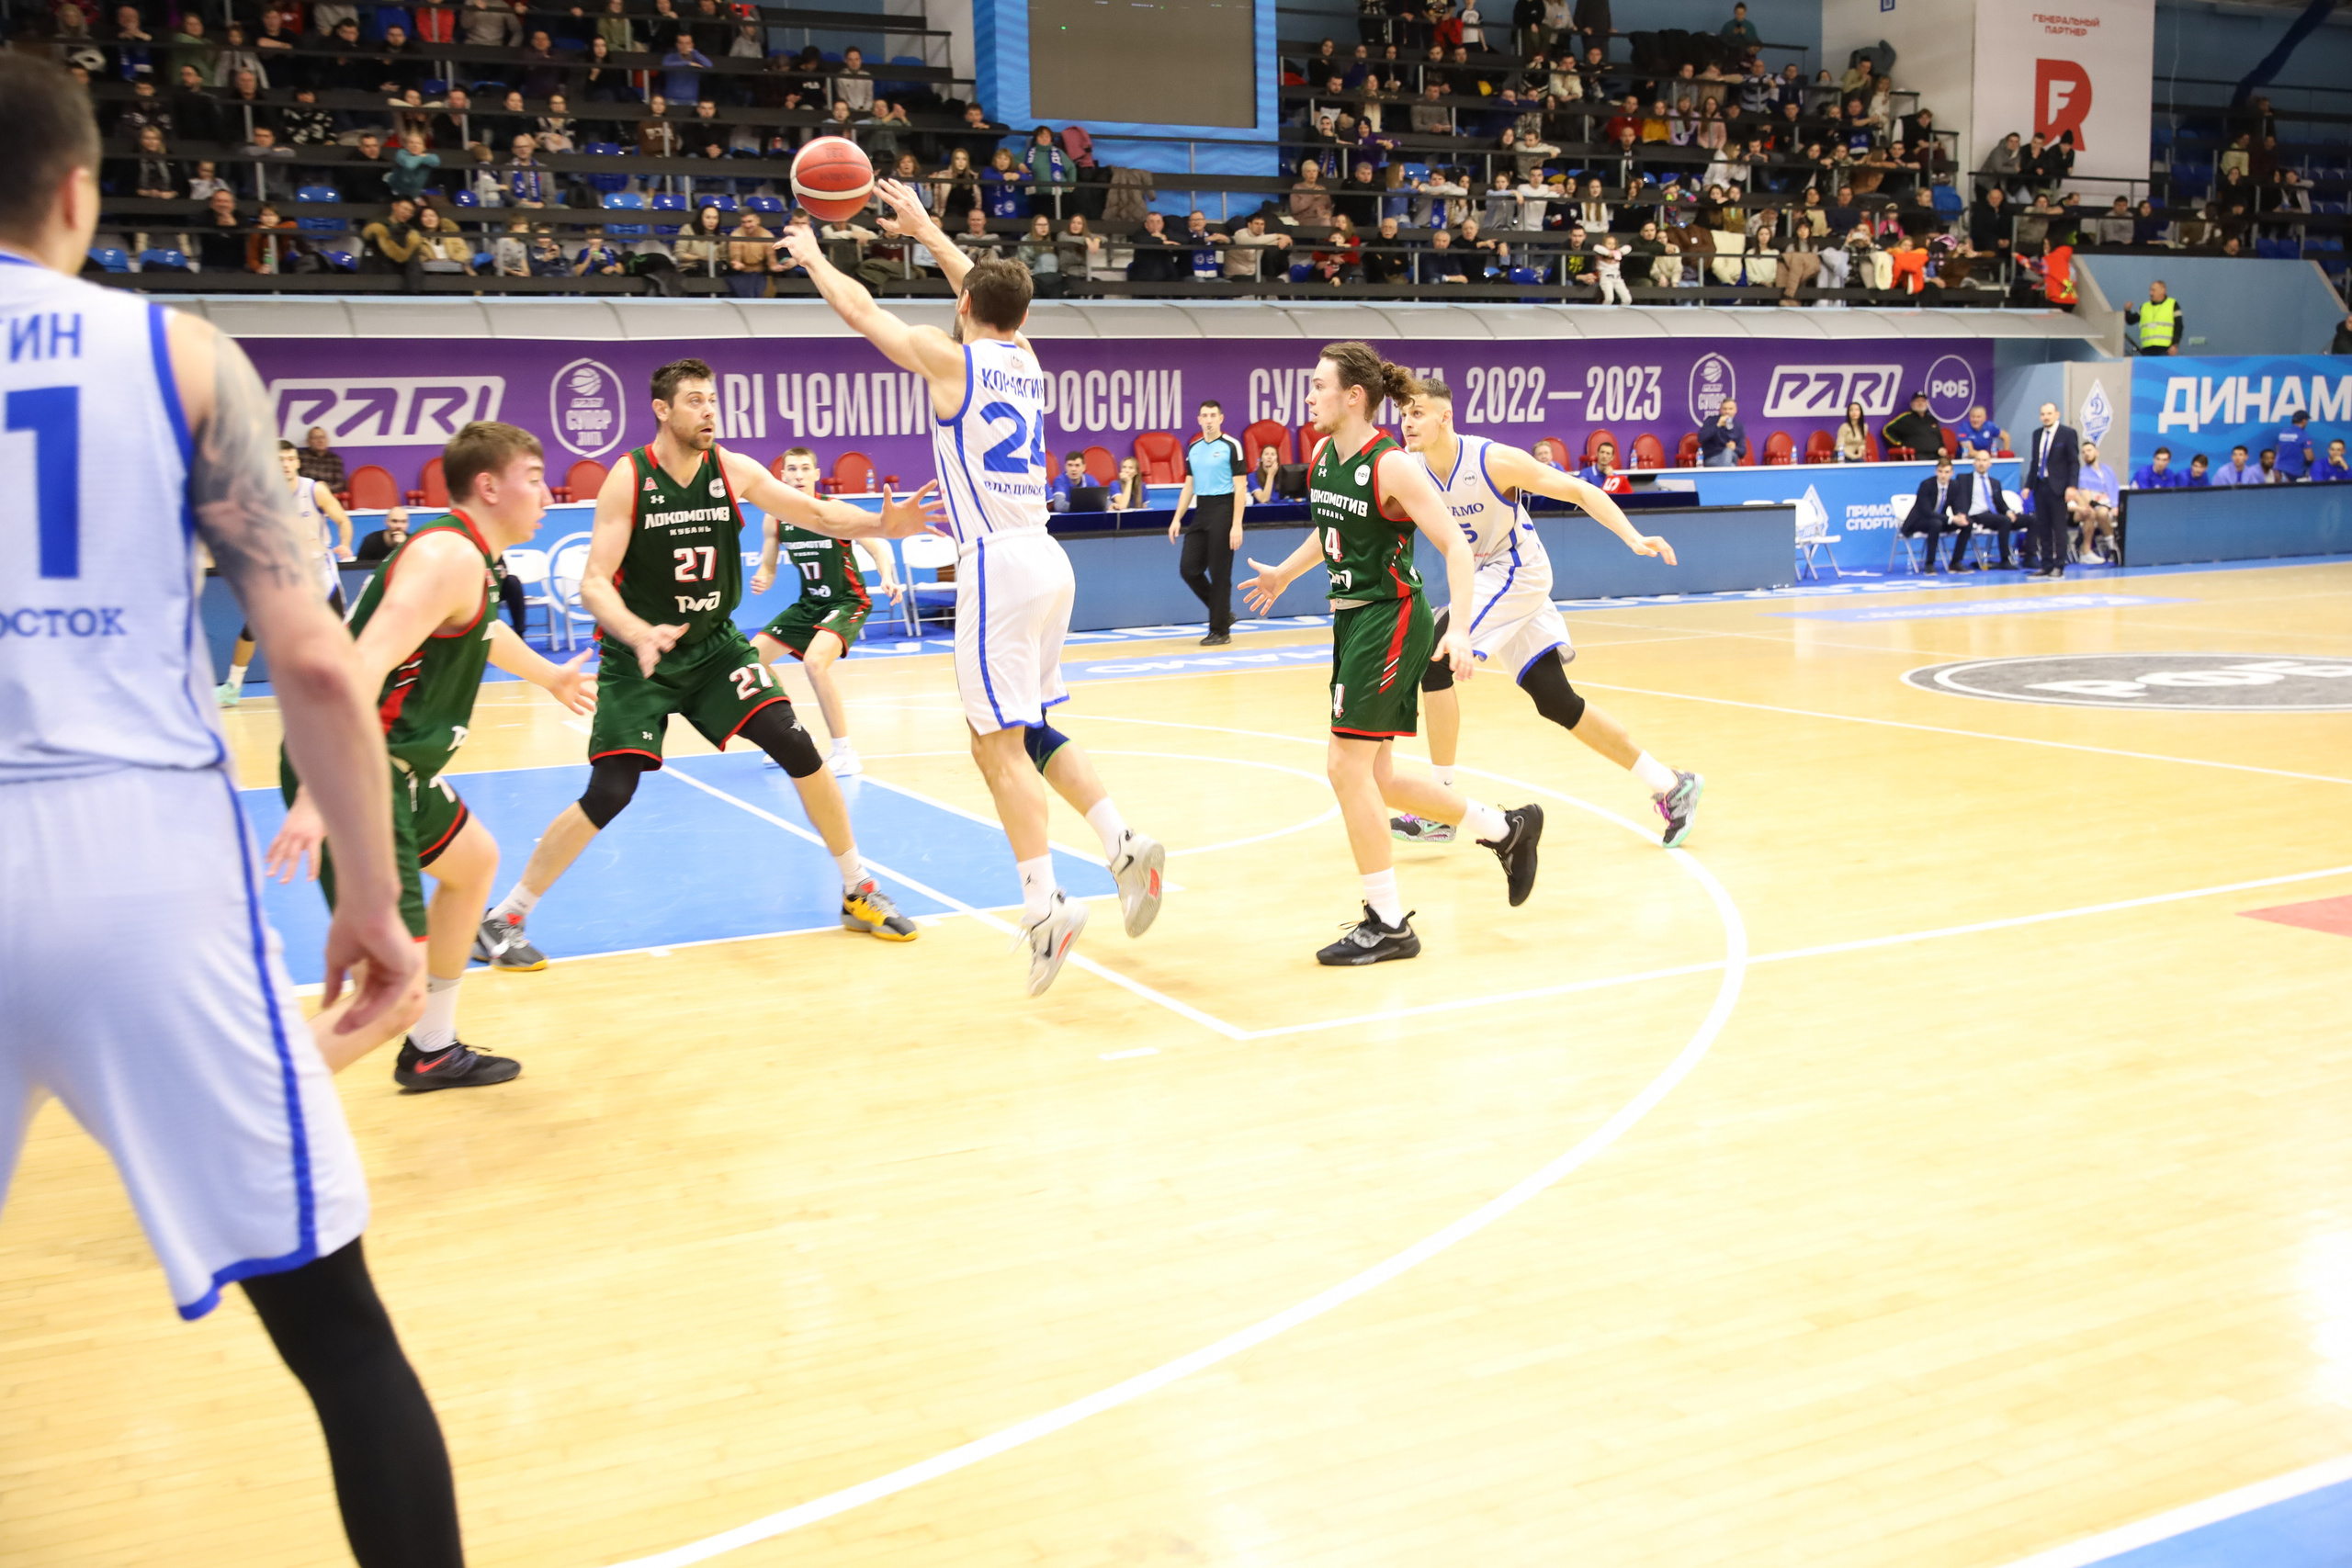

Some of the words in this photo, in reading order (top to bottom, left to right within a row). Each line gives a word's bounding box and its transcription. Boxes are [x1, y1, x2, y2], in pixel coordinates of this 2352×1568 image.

[2032, 14, 2100, 28] ГЕНЕРАЛЬНЫЙ
[2044, 26, 2087, 37] ПАРТНЕР
[0, 312, 81, 364] ИН
[1770, 371, 1896, 411] PARI
[1931, 379, 1970, 400] РФБ
[644, 506, 730, 530] ЛОКОМОТИВ
[1317, 507, 1345, 522] КУБАНЬ
[1846, 504, 1895, 518] ПРИМО
[669, 525, 712, 536] КУБАНЬ
[1846, 516, 1900, 531] СПОРТИ
[1324, 526, 1344, 562] 4
[673, 546, 718, 583] 27
[798, 561, 822, 581] 17
[0, 608, 127, 637] СТОК
[729, 661, 775, 700] 27
[1333, 682, 1345, 718] 4
